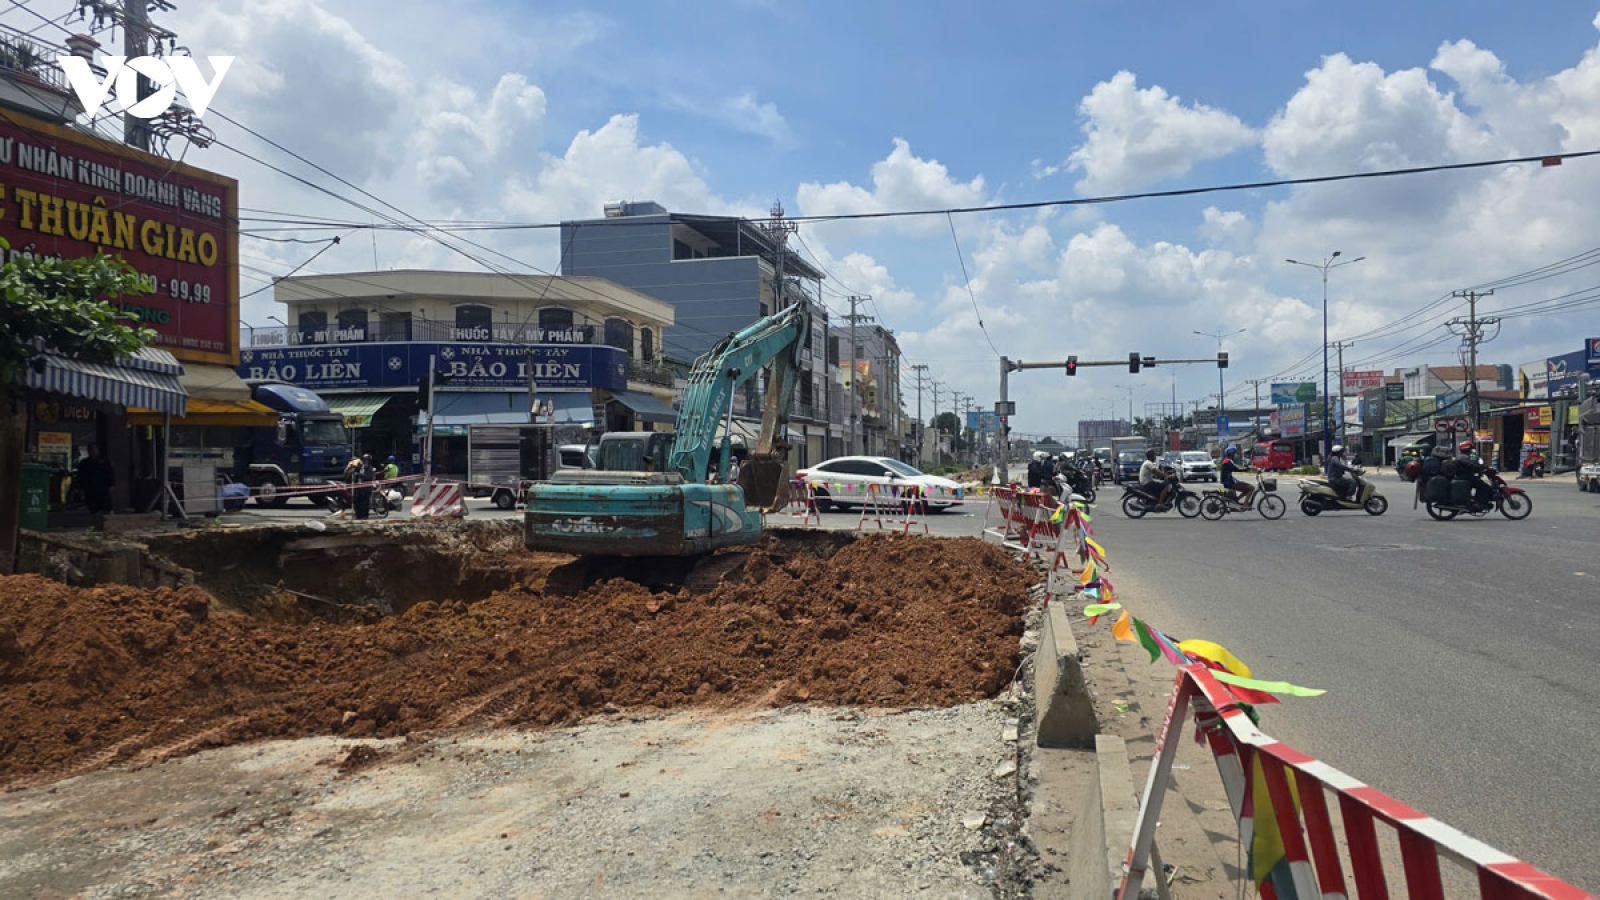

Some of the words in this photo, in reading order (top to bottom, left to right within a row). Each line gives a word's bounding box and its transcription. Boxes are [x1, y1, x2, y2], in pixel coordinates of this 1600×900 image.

[18, 145, 73, 181] NHÂN
[78, 159, 121, 193] KINH
[124, 173, 179, 206] DOANH
[183, 187, 221, 218] VÀNG
[140, 219, 218, 267] GIAO
[170, 279, 211, 304] 99,99
[461, 345, 491, 356] NHÀ
[249, 360, 297, 380] BẢO
[305, 358, 362, 380] LIÊN
[449, 355, 507, 377] BẢO
